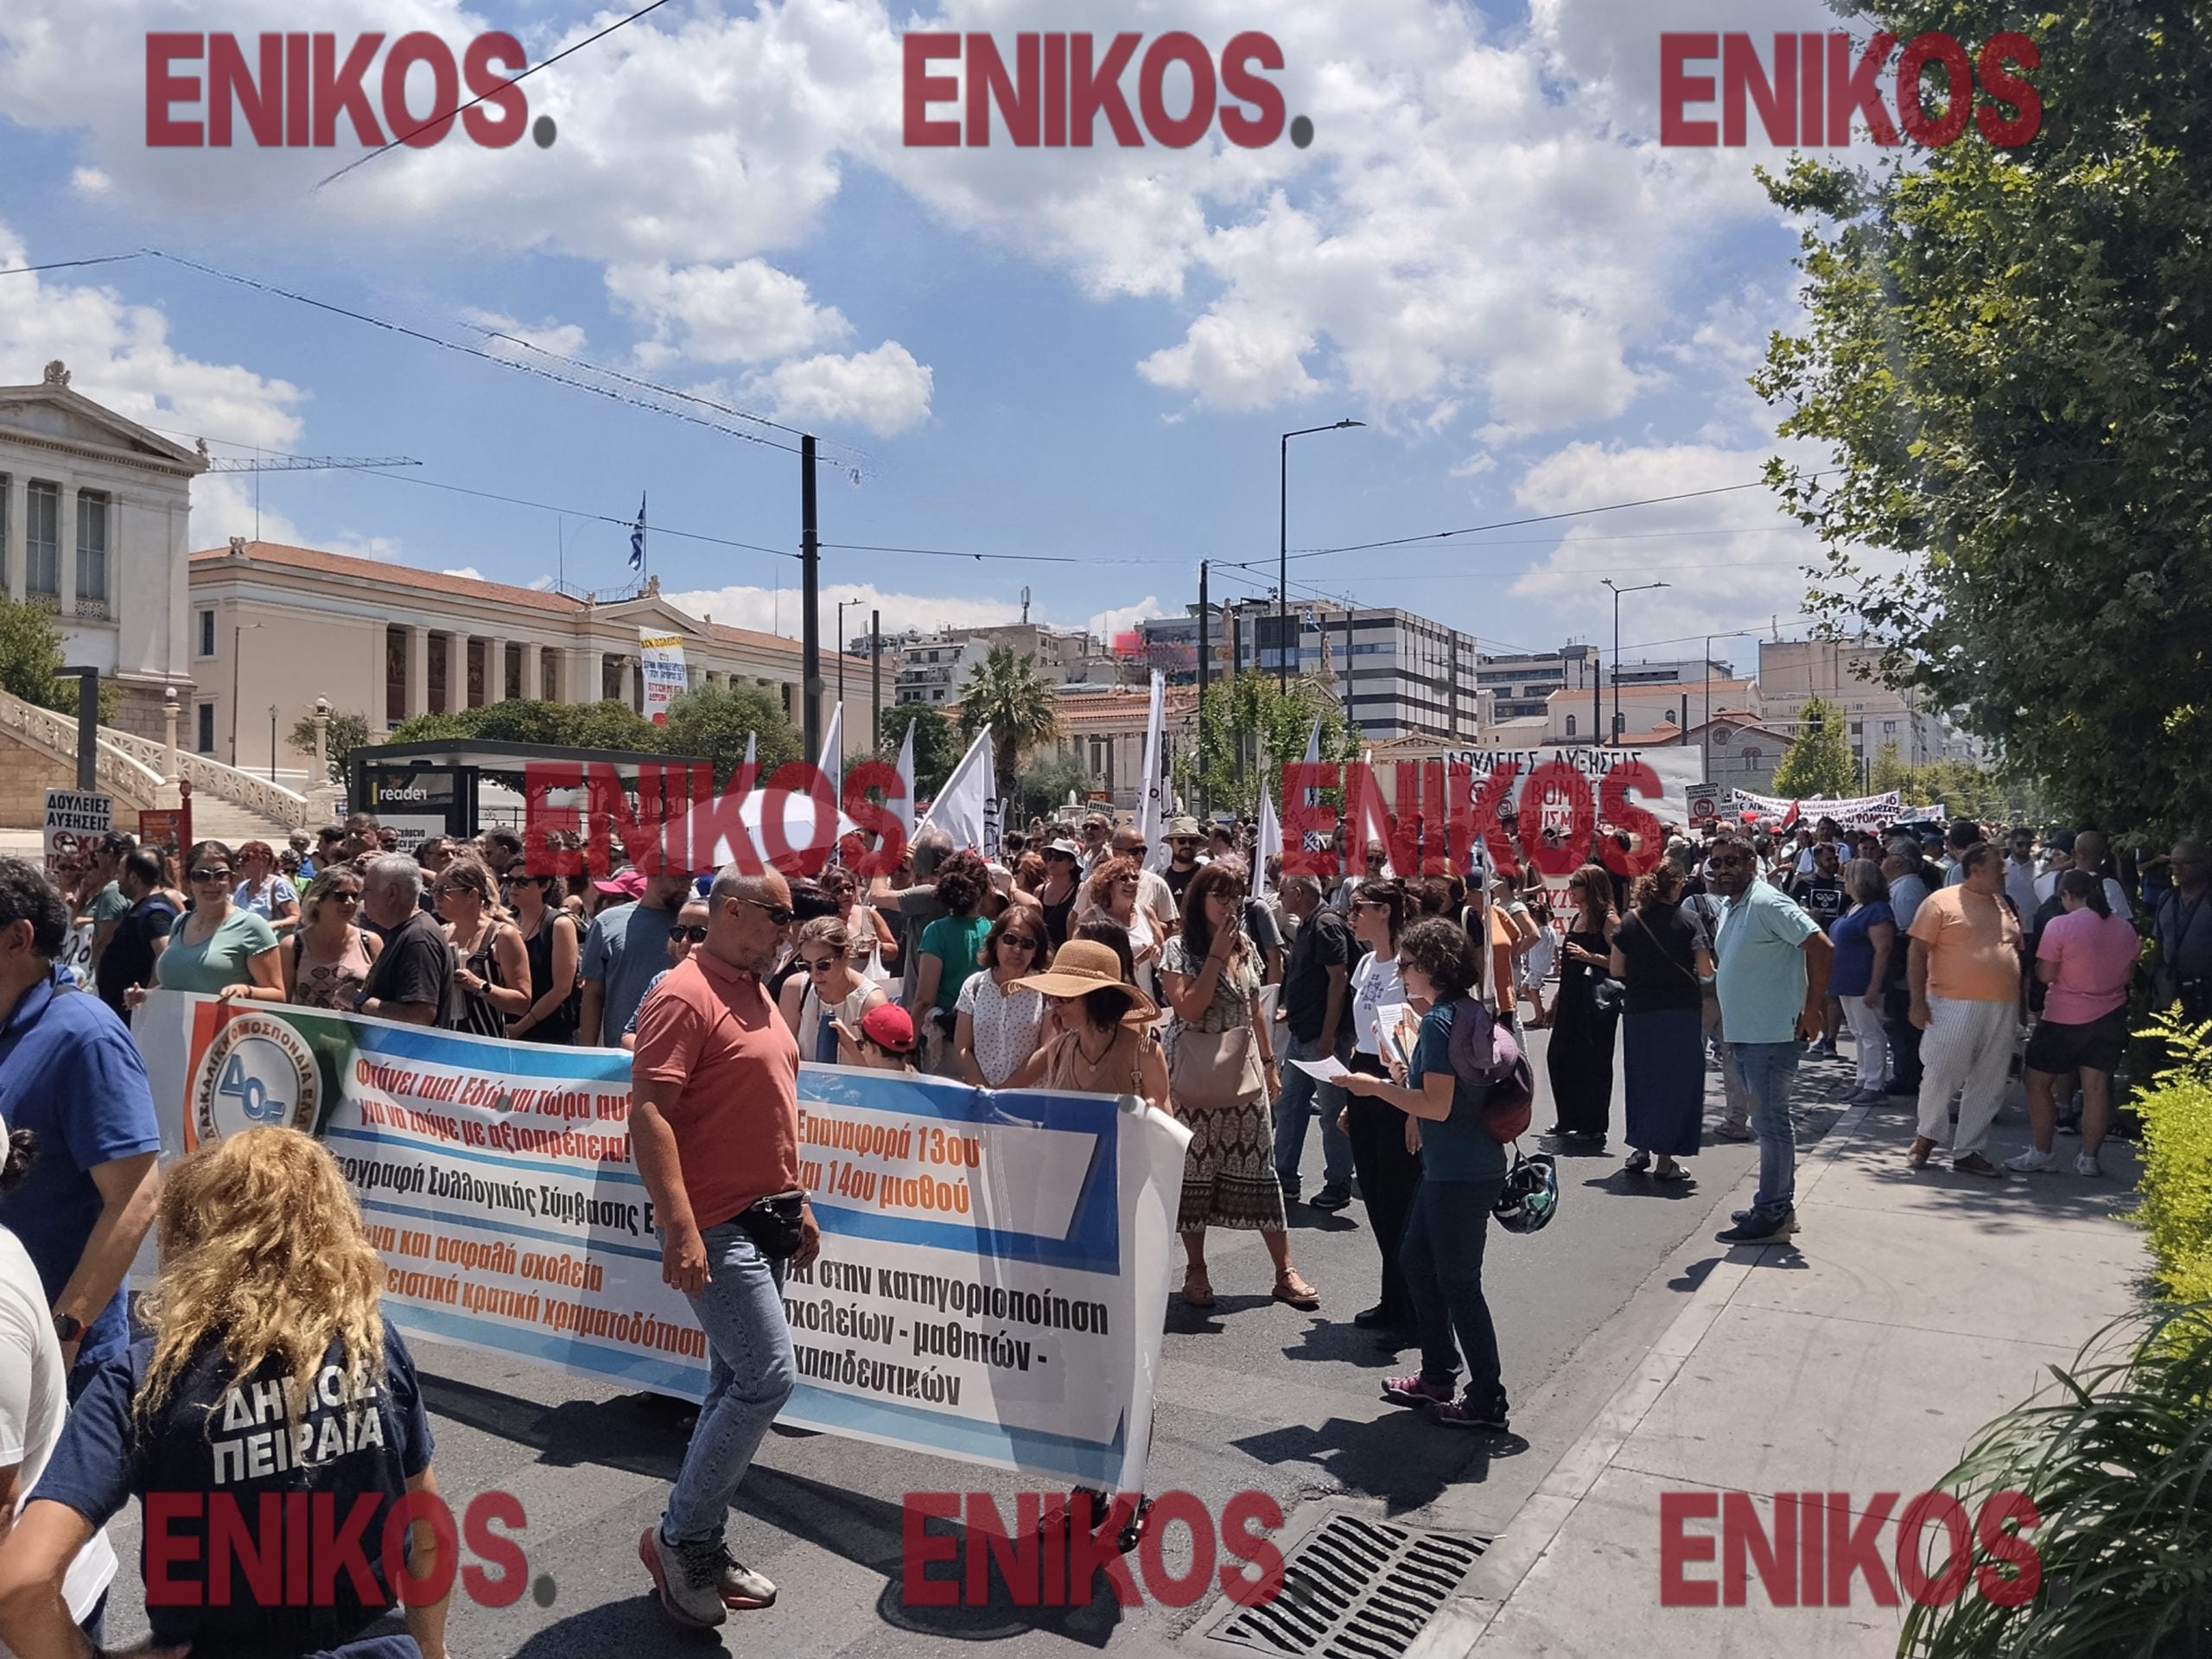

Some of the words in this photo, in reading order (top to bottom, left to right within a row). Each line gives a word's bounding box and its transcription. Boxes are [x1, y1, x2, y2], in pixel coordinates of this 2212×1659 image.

[1448, 751, 1539, 777] ΔΟΥΛΕΙΕΣ
[1553, 749, 1643, 777] ΑΥΞΗΣΕΙΣ
[47, 813, 109, 831] ΑΥΞΗΣΕΙΣ
[48, 794, 111, 814] ΔΟΥΛΕΙΕΣ
[356, 1058, 416, 1096] Φτάνει
[416, 1074, 462, 1104] πια!
[458, 1077, 506, 1110] Εδώ
[506, 1092, 537, 1114] και
[537, 1084, 591, 1121] τώρα
[359, 1098, 387, 1126] για
[388, 1103, 409, 1128] να
[410, 1108, 459, 1142] ζούμε
[463, 1121, 486, 1147] με
[488, 1120, 631, 1164] αξιοπρέπεια!
[798, 1109, 912, 1162] Επαναφορά
[917, 1125, 981, 1170] 13ου
[427, 1165, 537, 1218] Συλλογικής
[539, 1185, 639, 1236] Σύμβασης
[828, 1160, 877, 1202] 14ου
[880, 1173, 971, 1214] μισθού
[398, 1229, 432, 1260] και
[435, 1236, 518, 1275] ασφαλή
[520, 1251, 604, 1294] σχολεία
[461, 1281, 540, 1323] κρατική
[542, 1297, 708, 1360] χρηματοδότηση
[820, 1260, 872, 1295] στην
[878, 1267, 1109, 1335] κατηγοριοποίηση
[793, 1344, 961, 1406] κπαιδευτικών
[913, 1319, 1031, 1372] μαθητών
